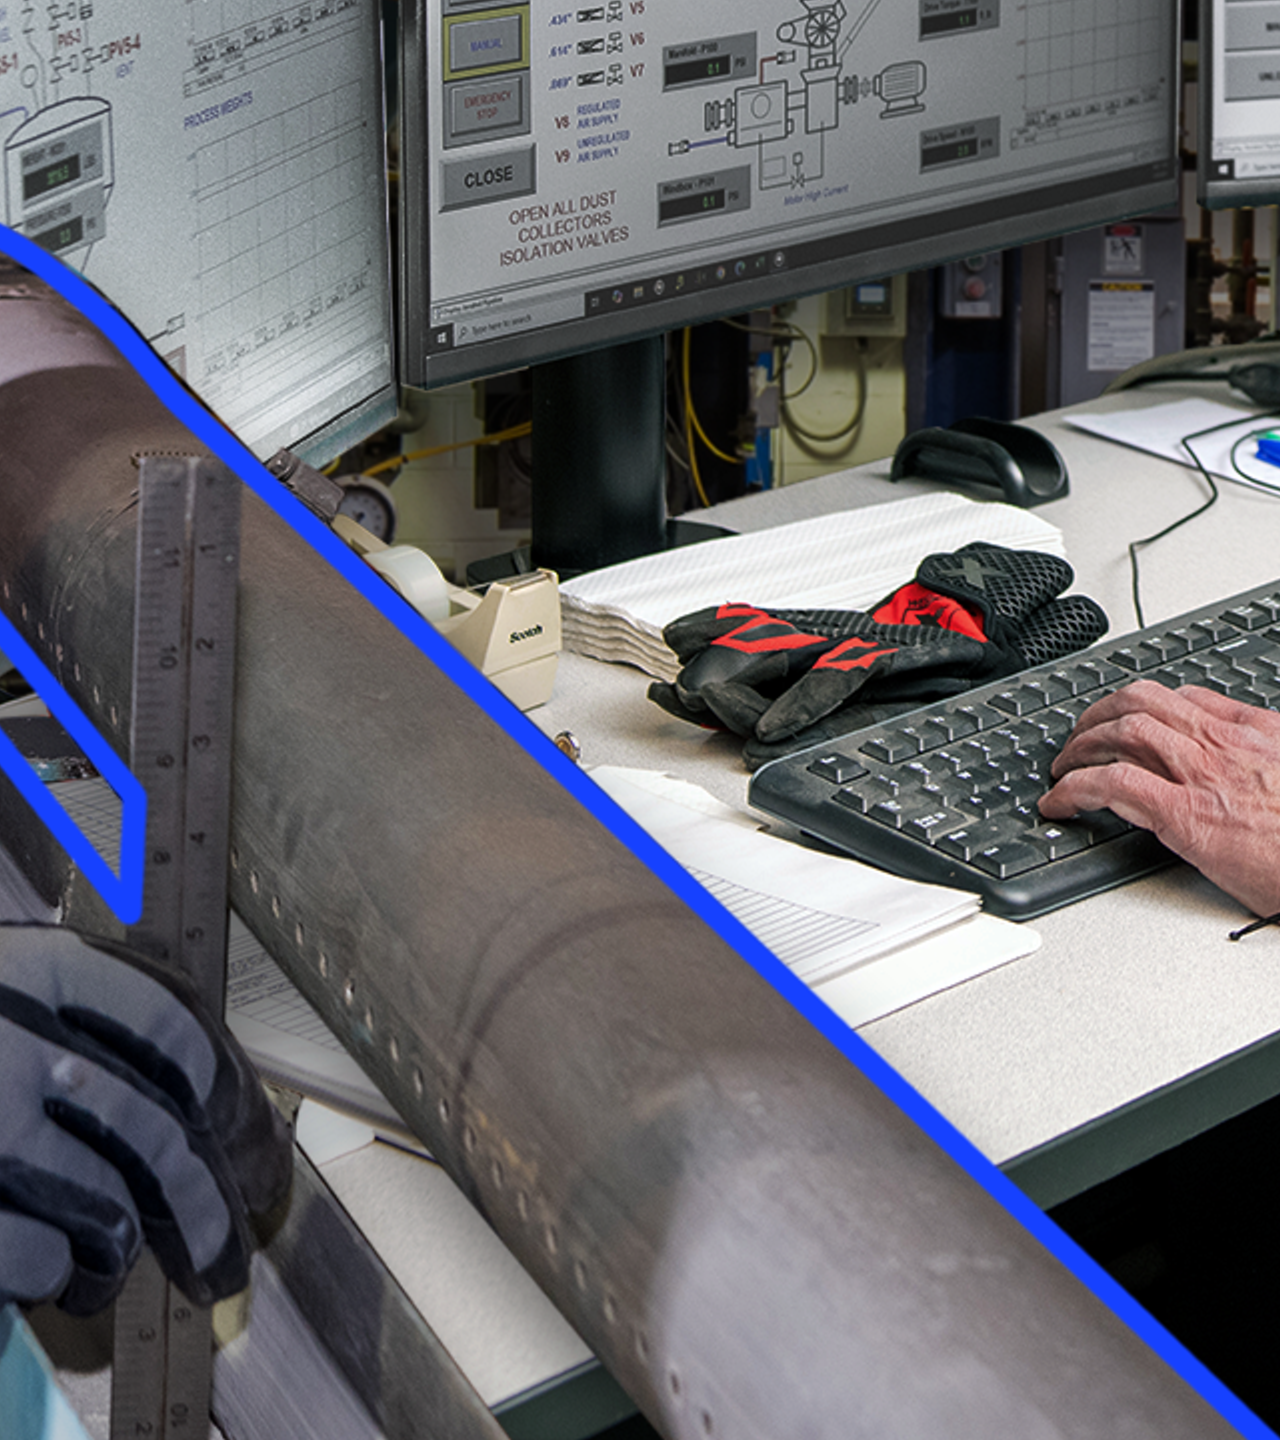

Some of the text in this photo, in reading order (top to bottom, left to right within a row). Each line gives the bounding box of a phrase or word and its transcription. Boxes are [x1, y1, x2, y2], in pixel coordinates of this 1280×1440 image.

[629, 1, 645, 15] V5
[470, 39, 502, 52] MANUAL
[629, 33, 645, 47] V6
[669, 45, 696, 58] Manifold
[629, 64, 645, 78] V7
[707, 63, 720, 74] 0.1
[464, 90, 511, 109] EMERGENCY
[577, 99, 620, 116] REGULATED
[184, 90, 253, 131] PROCESS WEIGHTS
[477, 107, 497, 120] STOP
[554, 116, 570, 129] V8
[577, 114, 619, 129] AIR SUPPLY
[577, 130, 631, 149] UNREGULATED
[554, 150, 570, 163] V9
[577, 148, 619, 163] AIR SUPPLY
[464, 166, 513, 188] CLOSE
[663, 181, 693, 194] Windbox
[784, 184, 849, 206] Motor High Current
[509, 190, 618, 225] OPEN ALL DUST
[703, 197, 715, 208] 0.1
[518, 211, 612, 243] COLLECTORS
[500, 226, 630, 267] ISOLATION VALVES
[509, 624, 544, 643] Scotch
[195, 636, 216, 653] 2
[192, 733, 212, 752] 3
[189, 830, 207, 846] 4
[185, 925, 205, 941] 5
[137, 1327, 157, 1343] 3
[135, 1420, 154, 1436] 2
